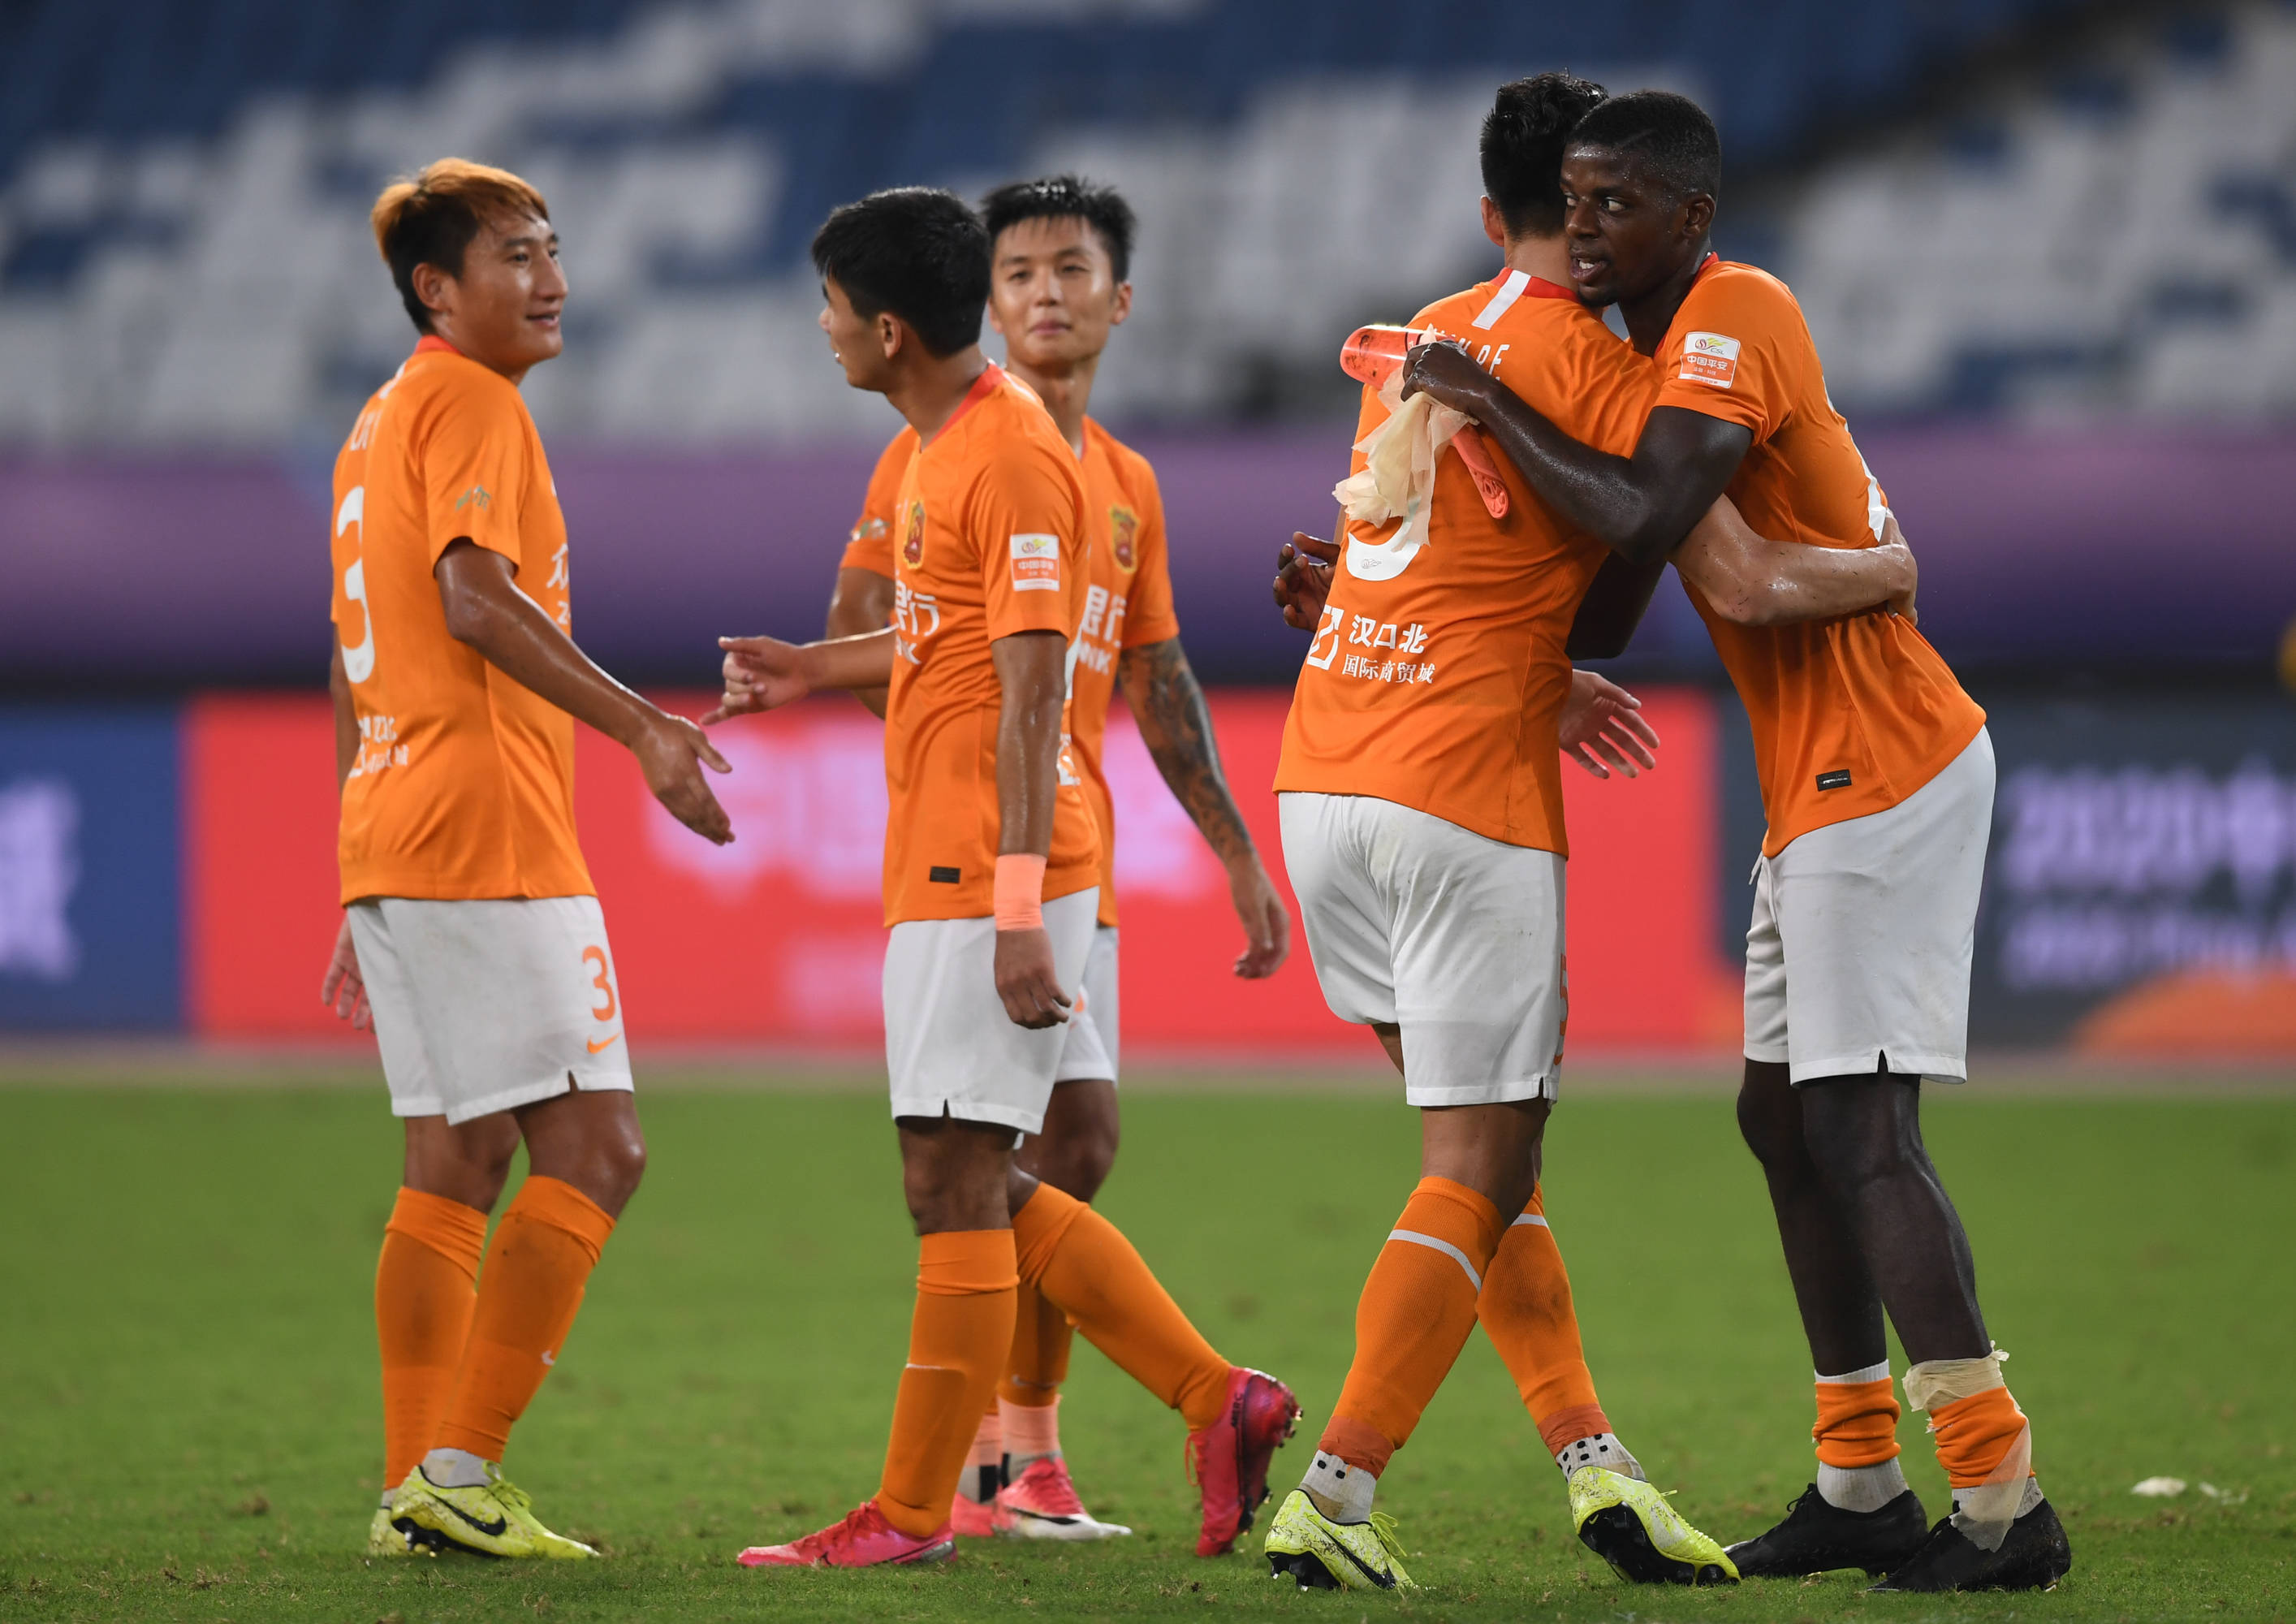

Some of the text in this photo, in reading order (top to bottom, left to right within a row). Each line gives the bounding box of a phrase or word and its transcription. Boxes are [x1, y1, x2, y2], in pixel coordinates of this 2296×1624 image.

[1687, 355, 1728, 371] 中国平安
[336, 485, 376, 684] 3
[1349, 614, 1429, 654] 汉口北
[1342, 654, 1436, 685] 国际商贸城
[582, 945, 615, 1022] 3
